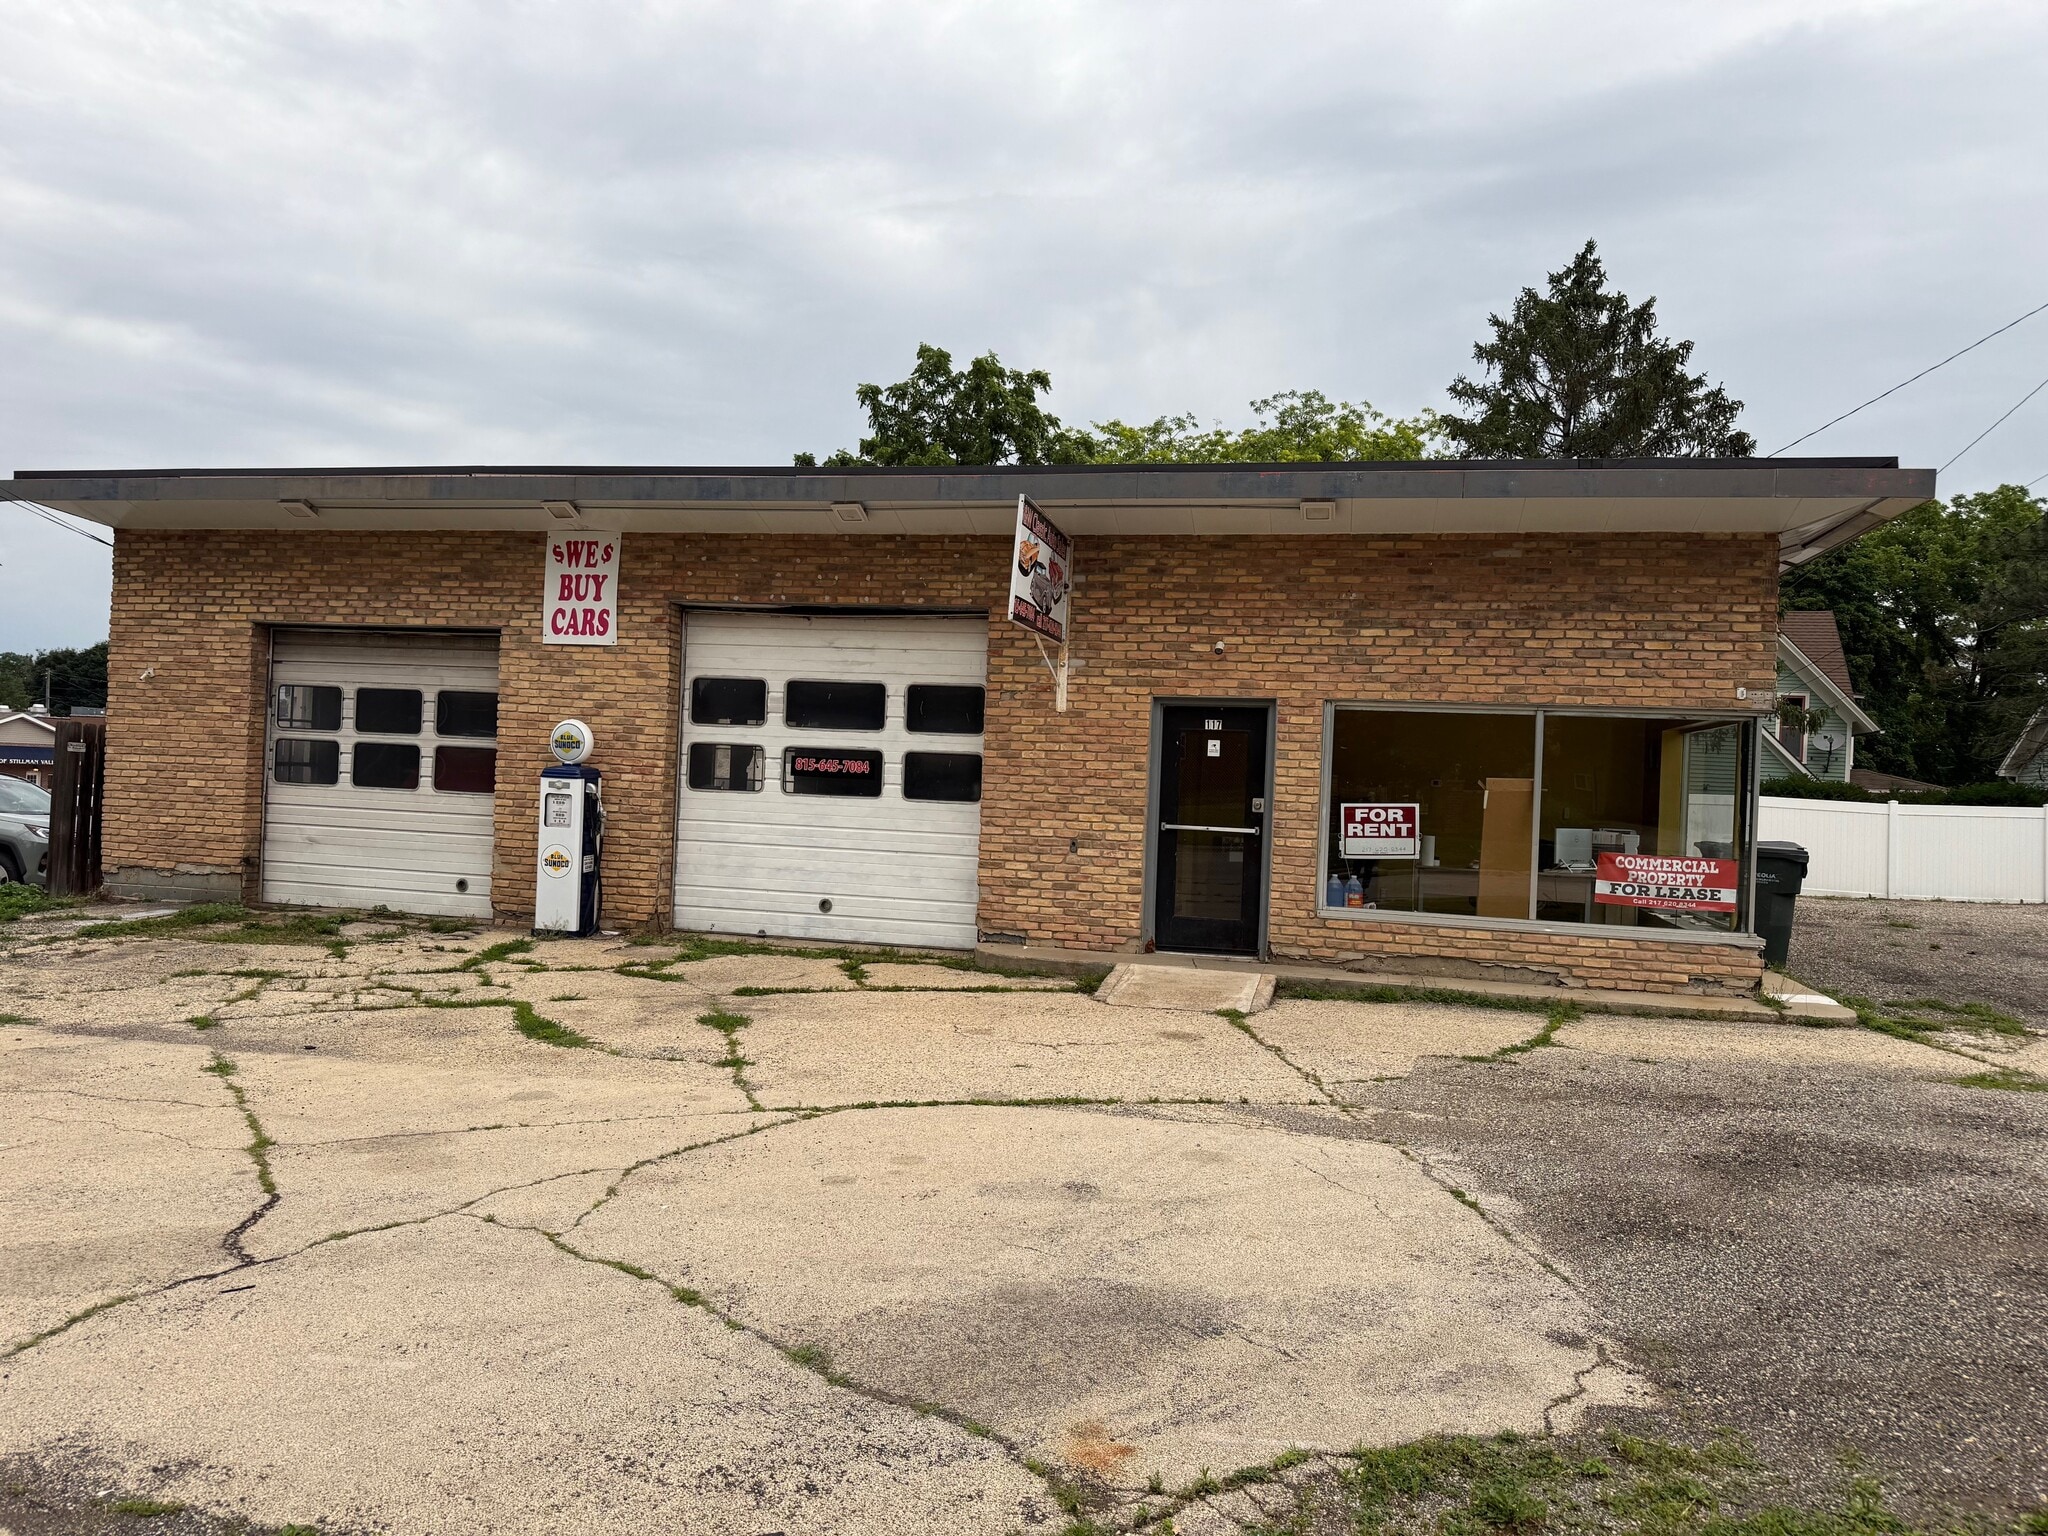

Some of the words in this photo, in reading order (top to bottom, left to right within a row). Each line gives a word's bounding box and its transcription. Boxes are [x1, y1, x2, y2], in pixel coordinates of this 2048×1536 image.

[558, 574, 608, 601] BUY
[551, 608, 610, 636] CARS
[1205, 720, 1222, 730] 117
[554, 740, 581, 749] SUNOCO
[795, 757, 870, 774] 815-645-7084
[1355, 808, 1404, 822] FOR
[1347, 823, 1412, 837] RENT
[544, 858, 570, 868] SUNOCO
[1615, 856, 1719, 874] COMMERCIAL
[1627, 871, 1705, 886] PROPERTY
[1609, 882, 1650, 897] FOR
[1655, 886, 1721, 901] LEASE
